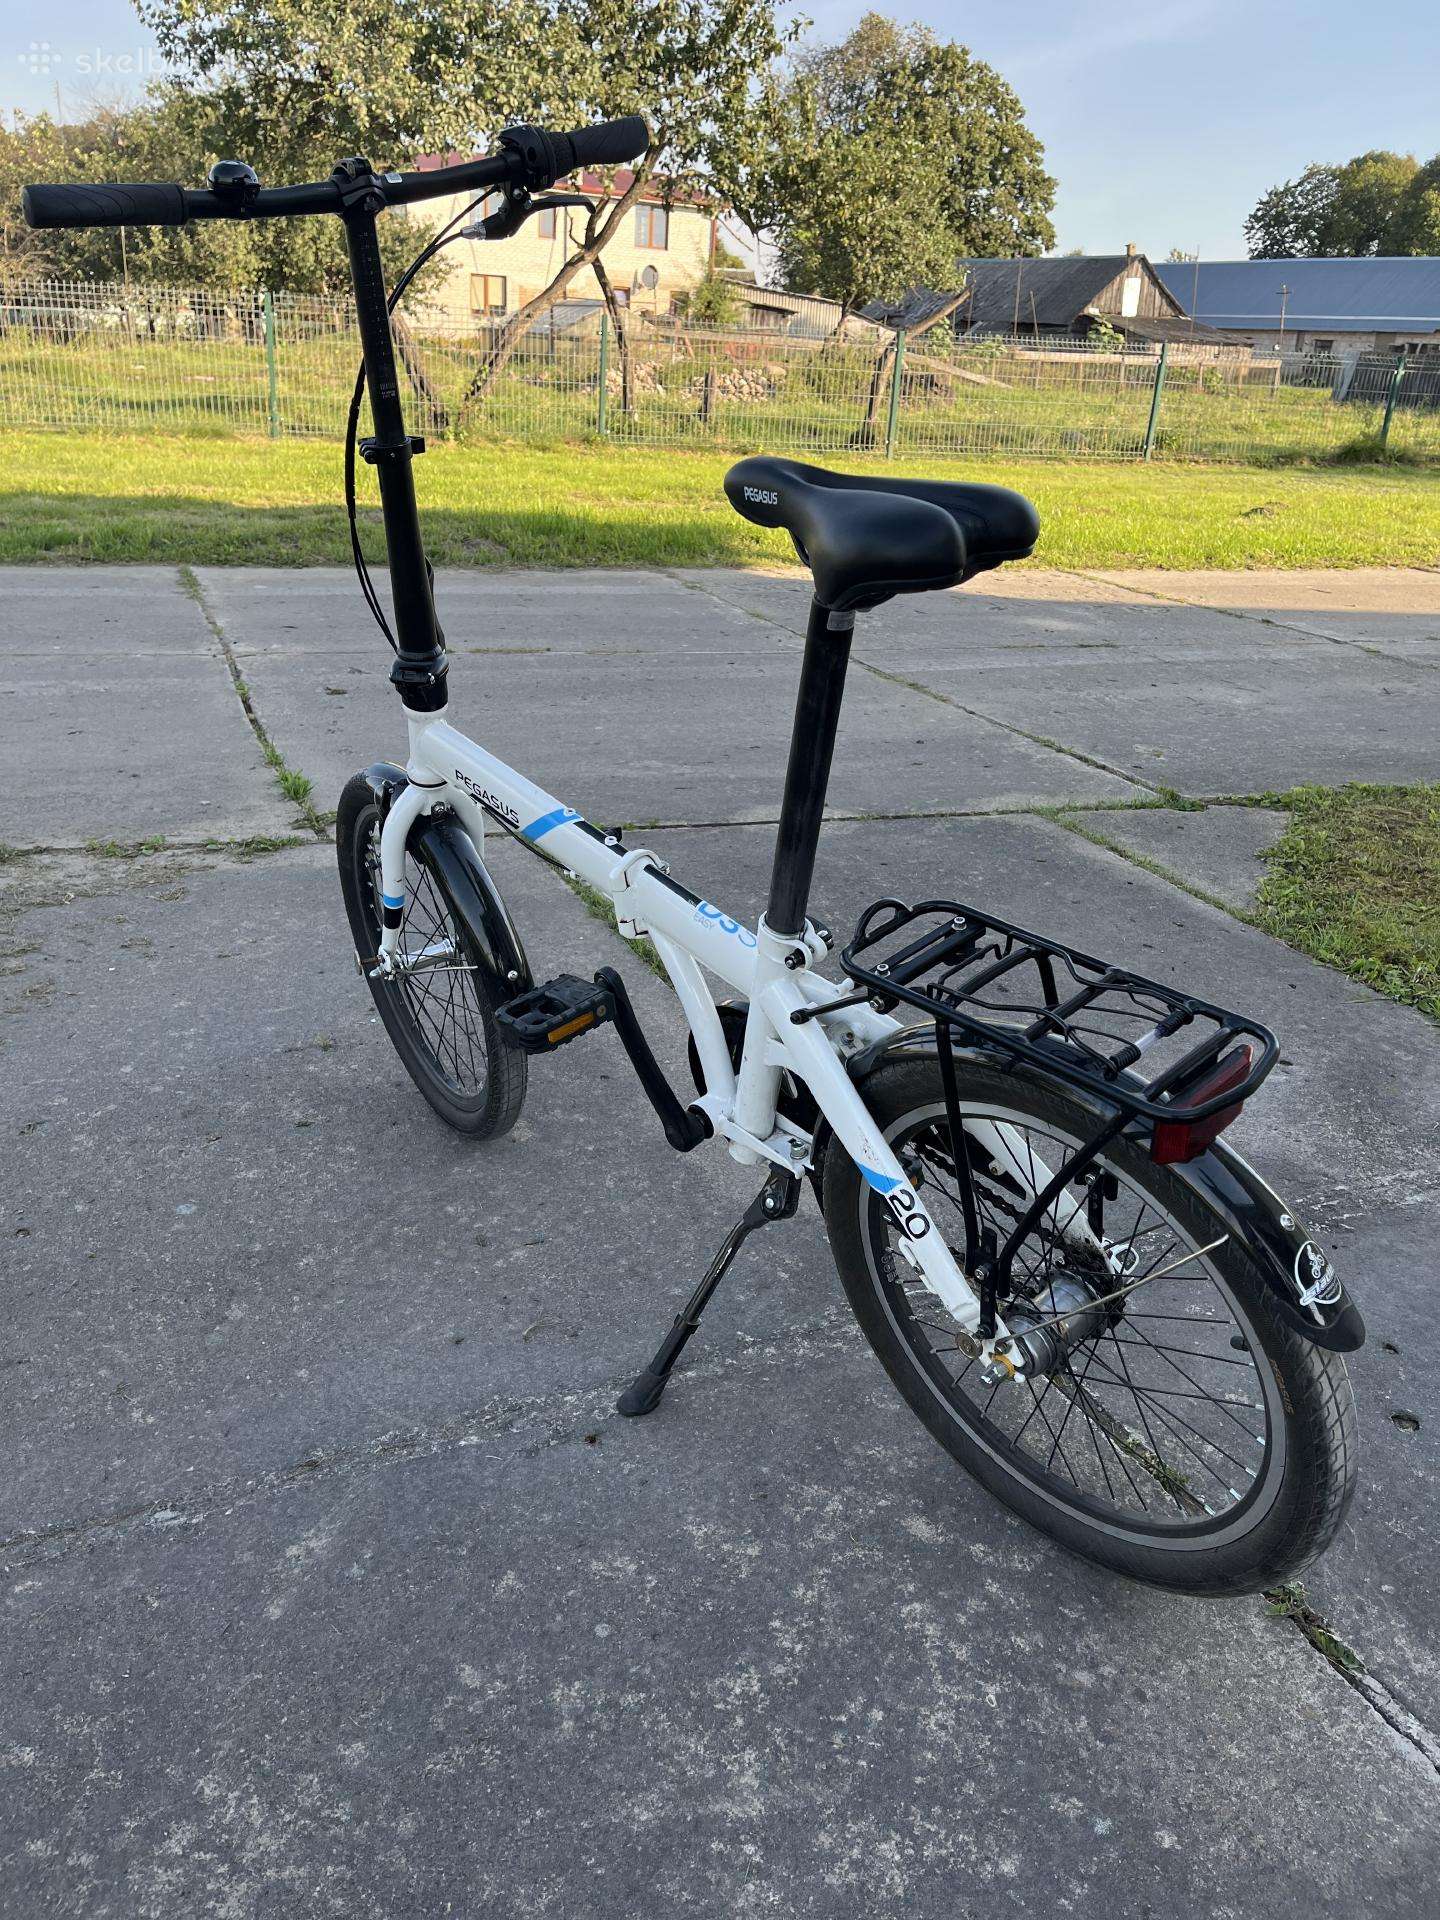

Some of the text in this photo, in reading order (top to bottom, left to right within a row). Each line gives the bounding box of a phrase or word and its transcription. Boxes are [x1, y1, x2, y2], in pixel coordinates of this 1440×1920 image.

[743, 486, 778, 505] PEGASUS
[455, 769, 519, 824] PEGASUS
[888, 1188, 931, 1239] 20
